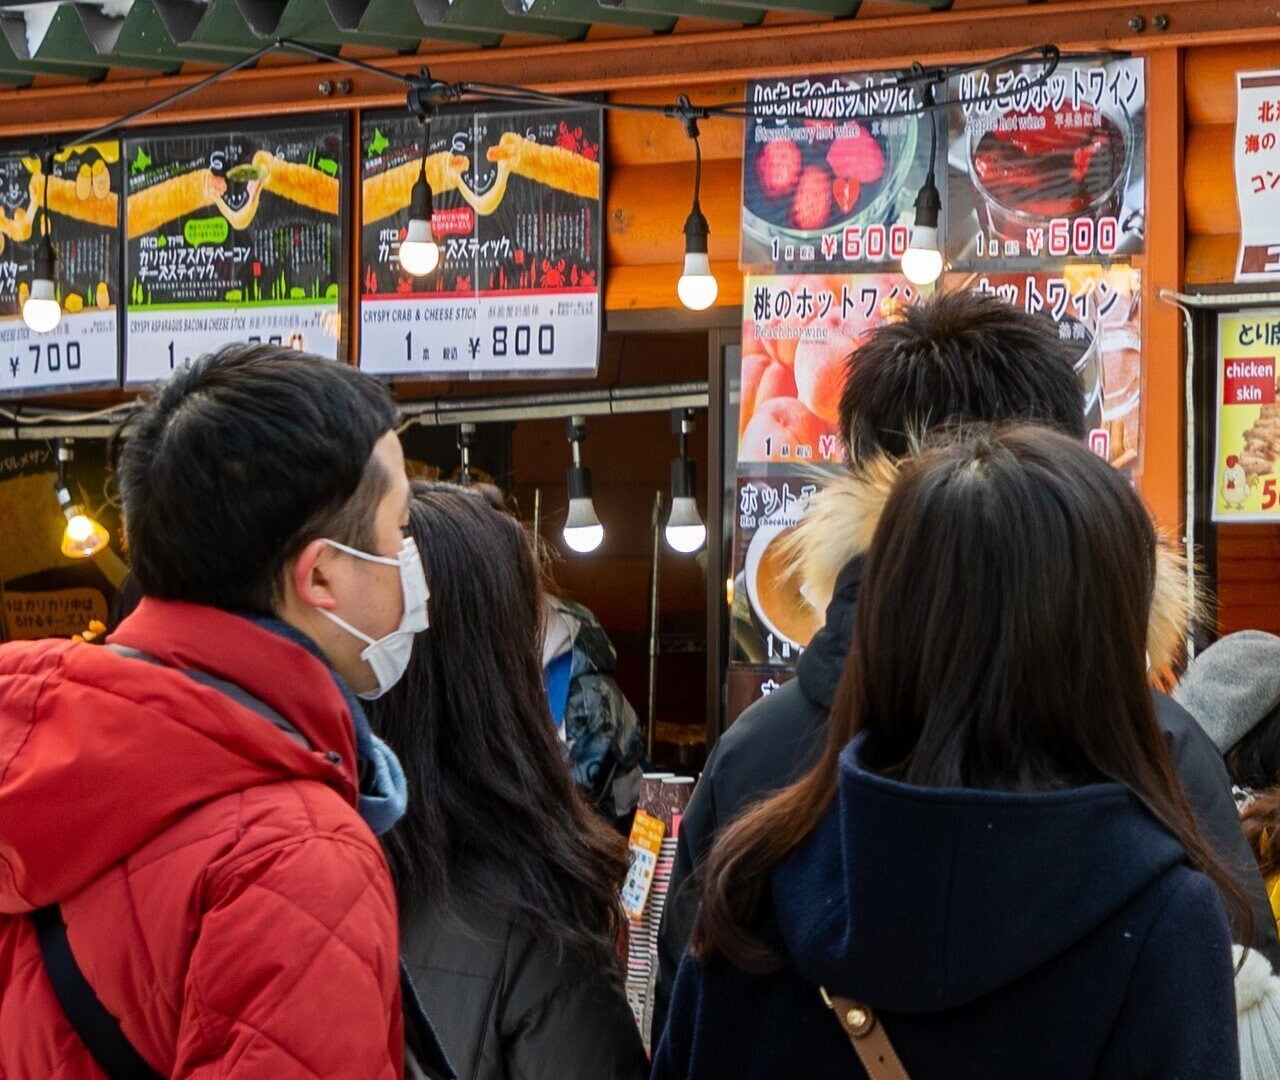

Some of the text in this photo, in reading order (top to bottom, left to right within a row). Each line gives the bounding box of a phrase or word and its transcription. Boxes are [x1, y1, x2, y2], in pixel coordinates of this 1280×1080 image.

[363, 308, 390, 322] CRYSPY
[392, 308, 412, 321] CRAB
[424, 308, 454, 321] CHEESE
[456, 307, 477, 321] STICK
[754, 325, 785, 339] Peach
[803, 325, 828, 338] wine
[405, 330, 412, 361] 1
[1226, 362, 1274, 378] chicken
[1236, 385, 1262, 400] skin
